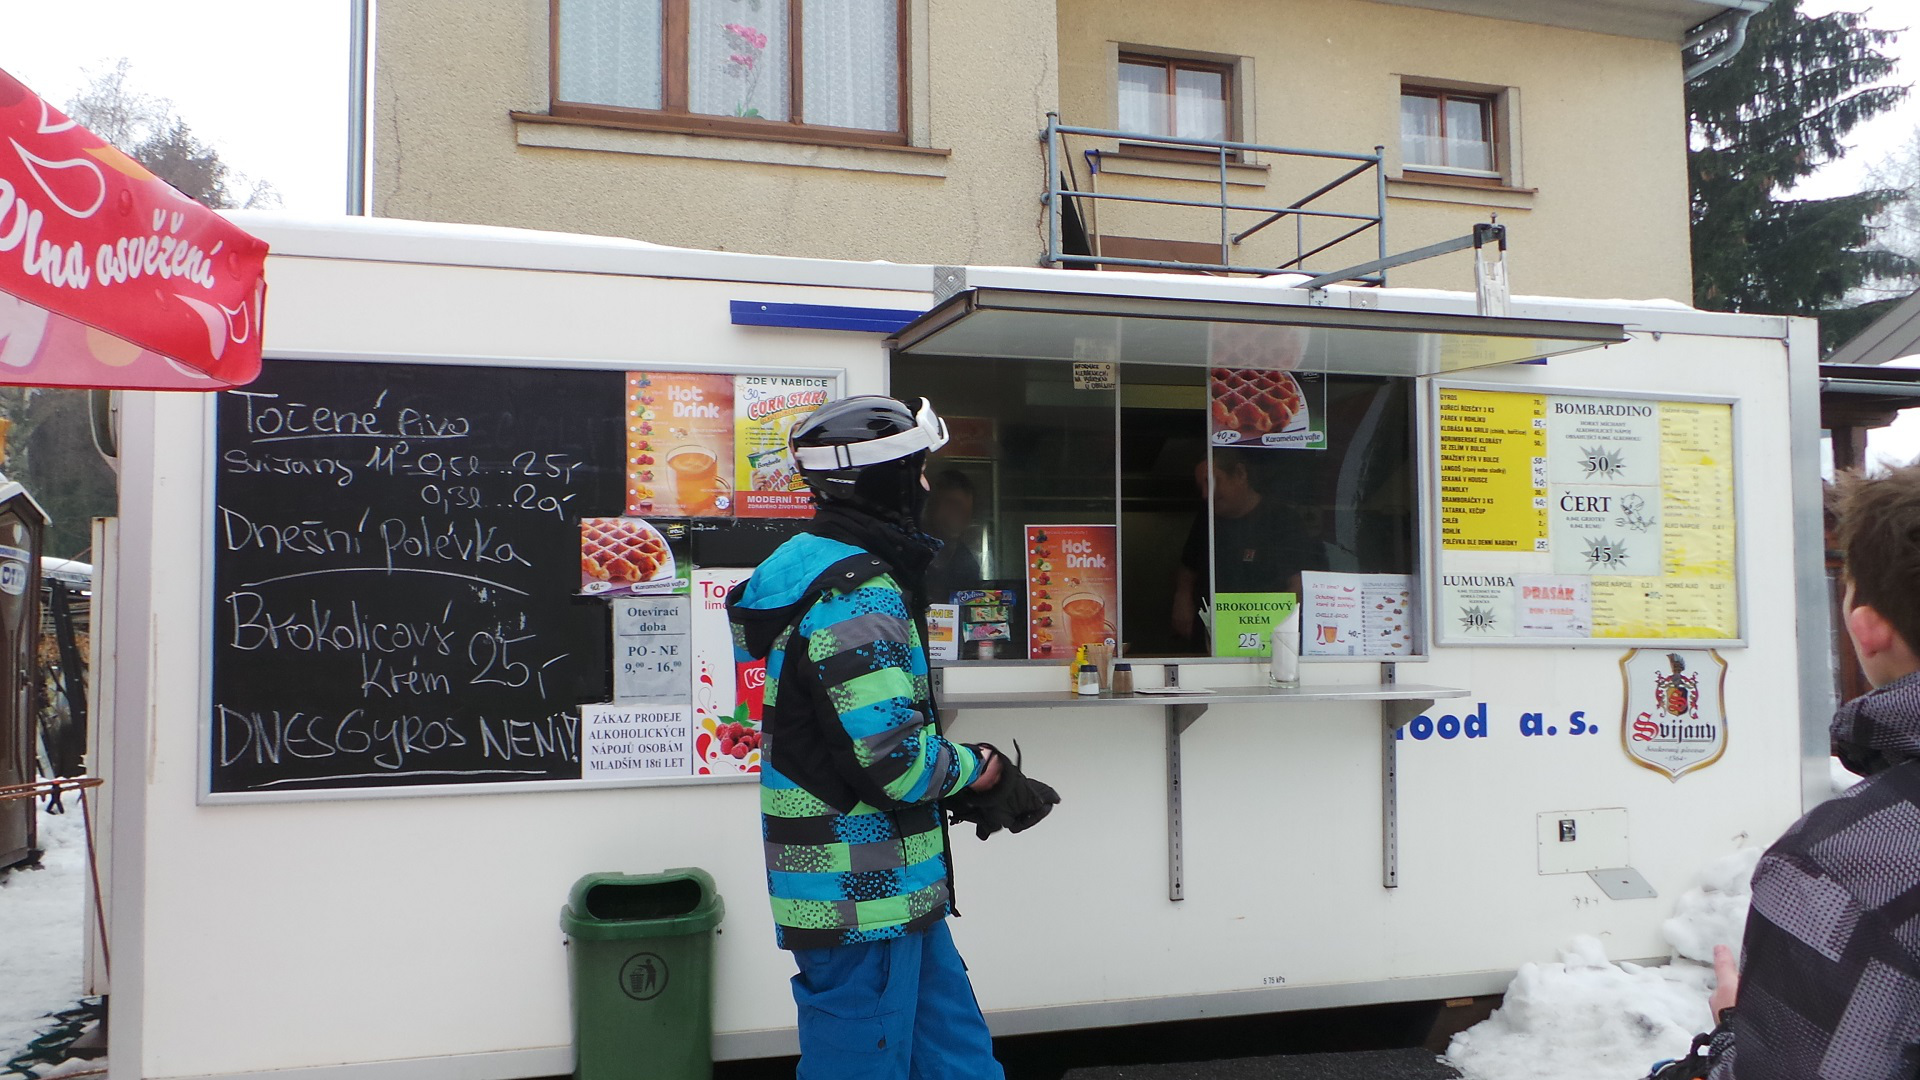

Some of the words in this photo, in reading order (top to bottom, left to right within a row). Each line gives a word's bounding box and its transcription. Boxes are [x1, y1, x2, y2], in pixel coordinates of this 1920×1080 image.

[746, 377, 767, 385] ZDE
[781, 378, 828, 387] NABÍDCE
[667, 385, 704, 402] Hot
[228, 389, 388, 434] Točené
[673, 401, 720, 419] Drink
[747, 395, 787, 420] CORN
[787, 390, 828, 408] STAR!
[1555, 402, 1652, 417] BOMBARDINO
[1265, 434, 1304, 443] Karamelová
[1588, 456, 1621, 474] 50,-
[746, 494, 792, 504] MODERNÍ
[1560, 491, 1612, 512] ČERT
[218, 506, 372, 554] Dnešní
[1061, 539, 1093, 554] Hot
[1066, 554, 1106, 569] Drink
[1591, 546, 1624, 564] 45,-
[1443, 575, 1515, 587] LUMUMBA
[627, 606, 679, 617] Otevírací
[1216, 600, 1293, 611] BROKOLICOVÝ
[225, 590, 455, 656] Brokolicový
[640, 622, 667, 632] doba
[1239, 614, 1271, 625] KRÉM
[628, 646, 647, 656] PO
[660, 645, 679, 656] NE
[593, 712, 631, 724] ZÁKAZ
[635, 712, 682, 723] PRODEJE
[589, 725, 685, 740] ALKOHOLICKÝCH
[1632, 711, 1716, 743] Svijany
[592, 742, 634, 754] NÁPOJŮ
[638, 740, 683, 753] OSOBÁM
[590, 757, 641, 770] MLADŠÍM
[645, 758, 661, 768] 18ti
[665, 758, 685, 768] LET
